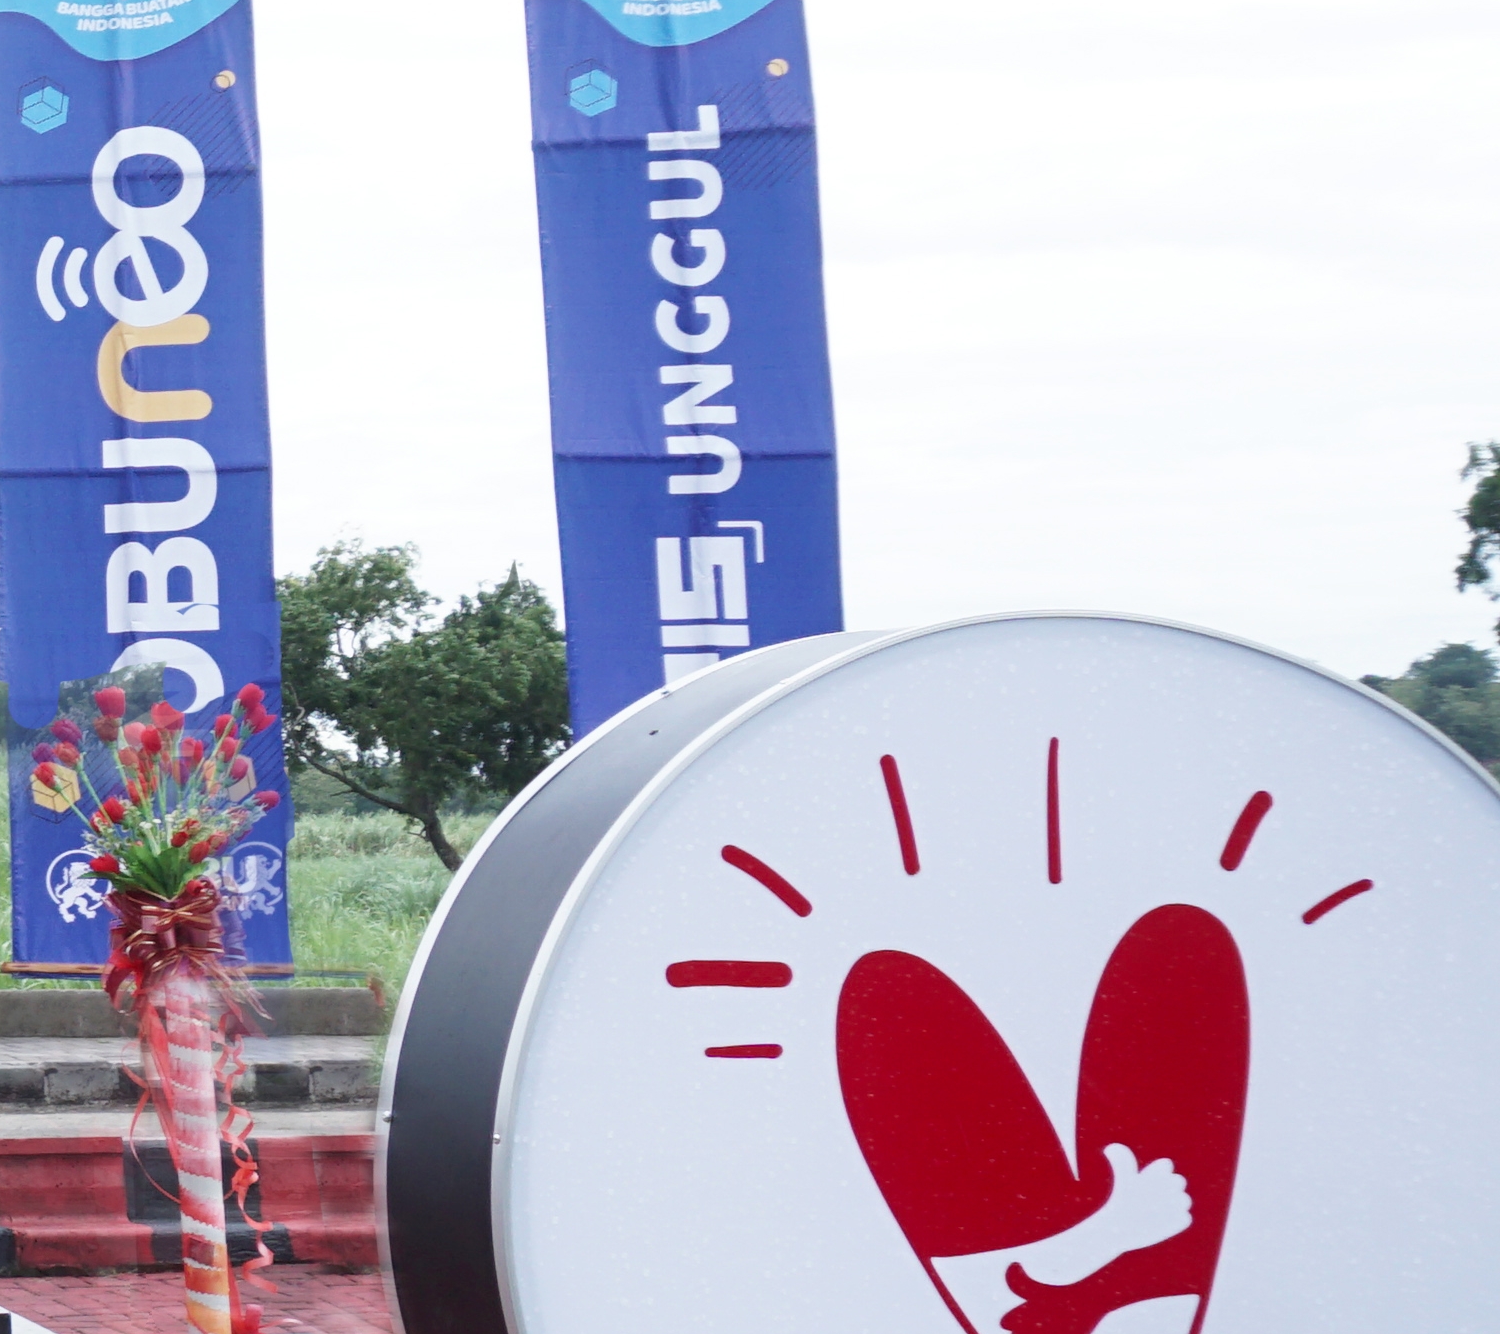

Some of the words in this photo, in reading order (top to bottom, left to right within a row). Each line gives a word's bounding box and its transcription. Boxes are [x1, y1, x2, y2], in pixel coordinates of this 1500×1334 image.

[57, 1, 124, 17] BANGGA
[622, 0, 722, 16] INDONESIA
[76, 11, 173, 32] INDONESIA
[648, 105, 743, 494] UNGGUL
